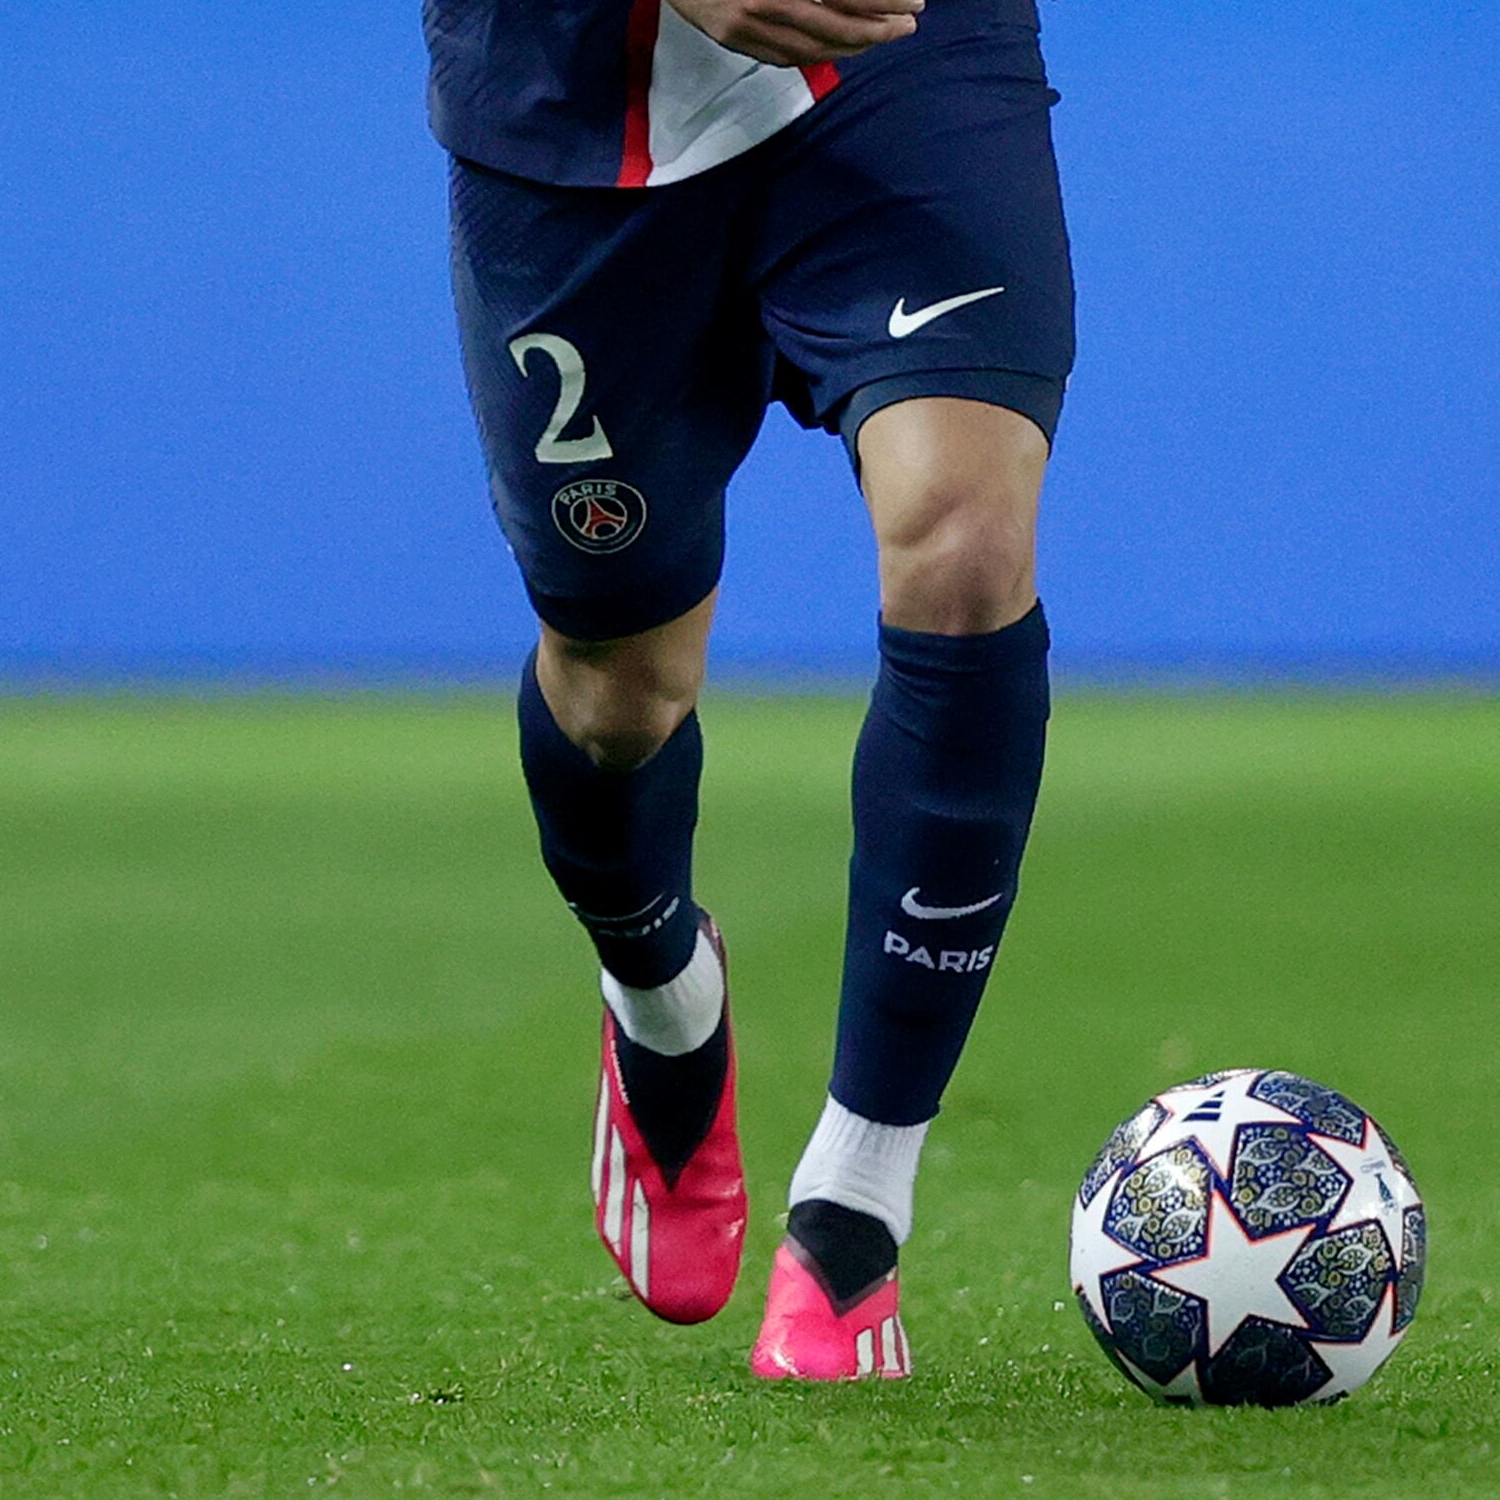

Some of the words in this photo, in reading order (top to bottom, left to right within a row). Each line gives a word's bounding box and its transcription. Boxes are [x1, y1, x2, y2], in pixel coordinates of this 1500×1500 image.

[508, 332, 614, 464] 2
[559, 483, 617, 506] PARIS
[883, 929, 994, 973] PARIS
